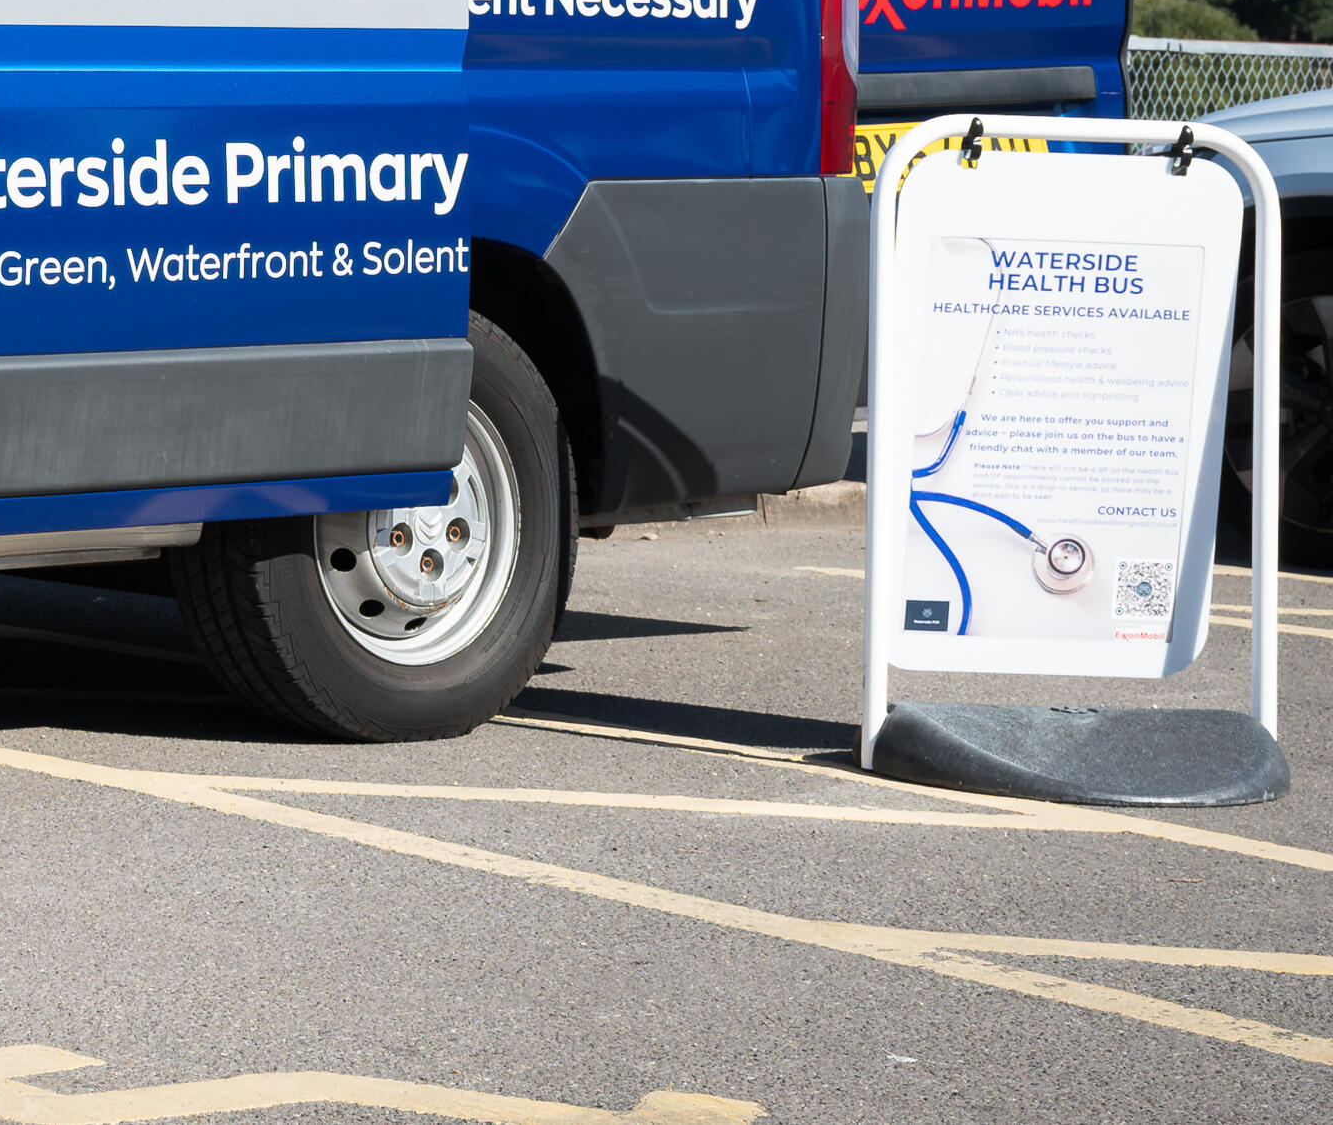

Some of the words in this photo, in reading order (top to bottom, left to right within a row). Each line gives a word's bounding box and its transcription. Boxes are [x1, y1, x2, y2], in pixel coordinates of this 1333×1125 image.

[226, 136, 468, 215] Primary
[127, 242, 323, 282] Waterfront
[333, 243, 353, 276] &
[363, 238, 468, 275] Solent
[991, 250, 1139, 272] WATERSIDE
[988, 273, 1085, 293] HEALTH
[1094, 276, 1144, 295] BUS
[933, 302, 1029, 316] HEALTHCARE
[1034, 305, 1104, 318] SERVICES
[1109, 308, 1190, 321] AVAILABLE
[1061, 330, 1095, 340] checks
[1077, 345, 1112, 355] checks
[1107, 377, 1155, 389] wellbeing
[1157, 377, 1190, 387] advice
[981, 413, 998, 422] We
[1000, 415, 1017, 423] are
[1019, 414, 1042, 424] here
[1045, 416, 1055, 424] to
[1058, 415, 1083, 425] offer
[1085, 418, 1104, 427] you
[1106, 418, 1146, 428] support
[1148, 418, 1169, 427] and
[965, 428, 998, 436] advice
[1009, 429, 1042, 439] please
[1044, 429, 1064, 440] join
[1097, 432, 1114, 441] the
[1116, 433, 1135, 442] bus
[1151, 434, 1176, 443] have
[969, 443, 1008, 455] friendly
[1011, 444, 1033, 453] chat
[1036, 445, 1059, 454] with
[1070, 448, 1113, 457] member
[1116, 448, 1127, 456] of
[1149, 450, 1178, 458] team.
[974, 462, 1000, 470] Please
[1097, 506, 1157, 517] CONTACT
[1160, 507, 1176, 518] US
